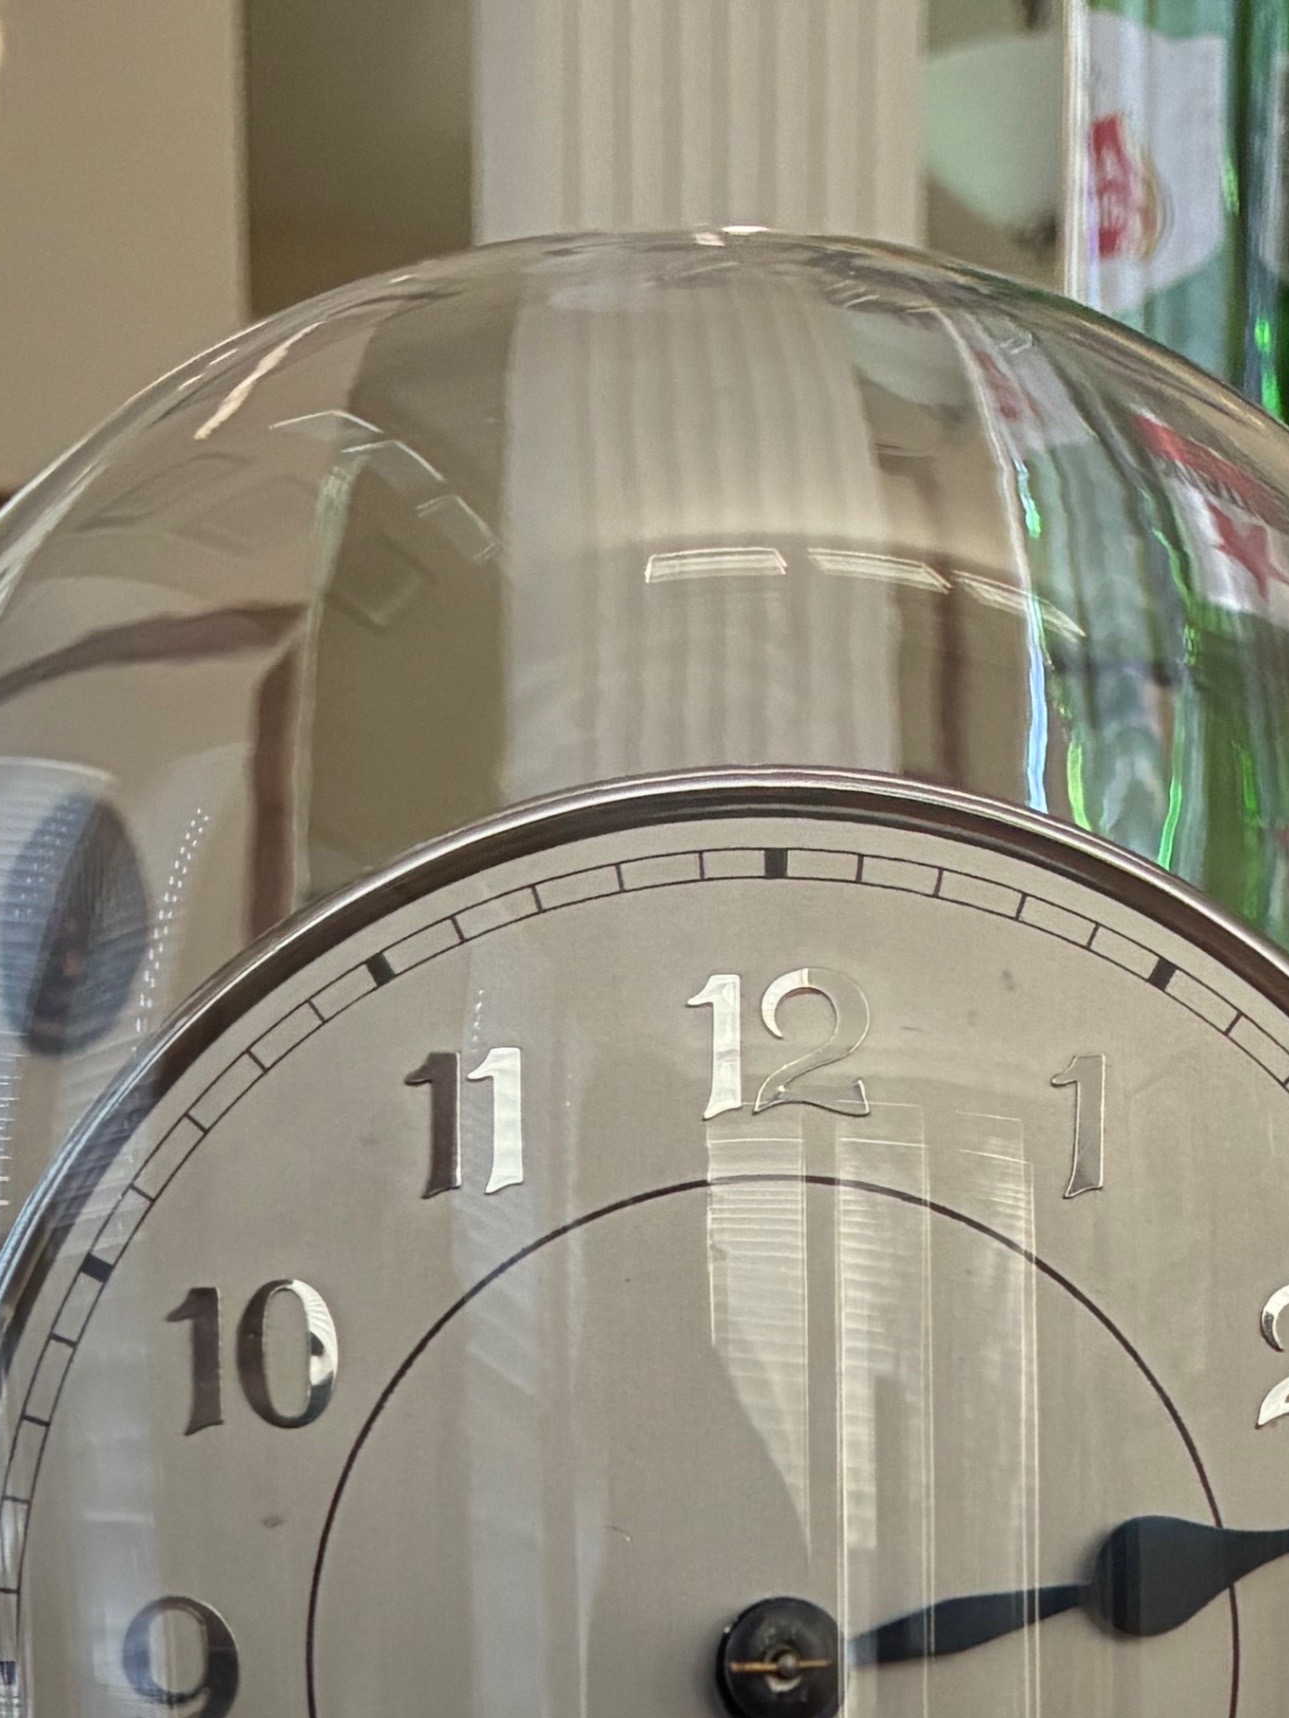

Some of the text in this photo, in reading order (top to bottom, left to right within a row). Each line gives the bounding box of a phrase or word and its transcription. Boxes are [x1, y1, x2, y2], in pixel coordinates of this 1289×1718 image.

[687, 966, 875, 1121] 12
[404, 1045, 524, 1199] 11
[1049, 1052, 1108, 1200] 1
[167, 1278, 340, 1436] 10
